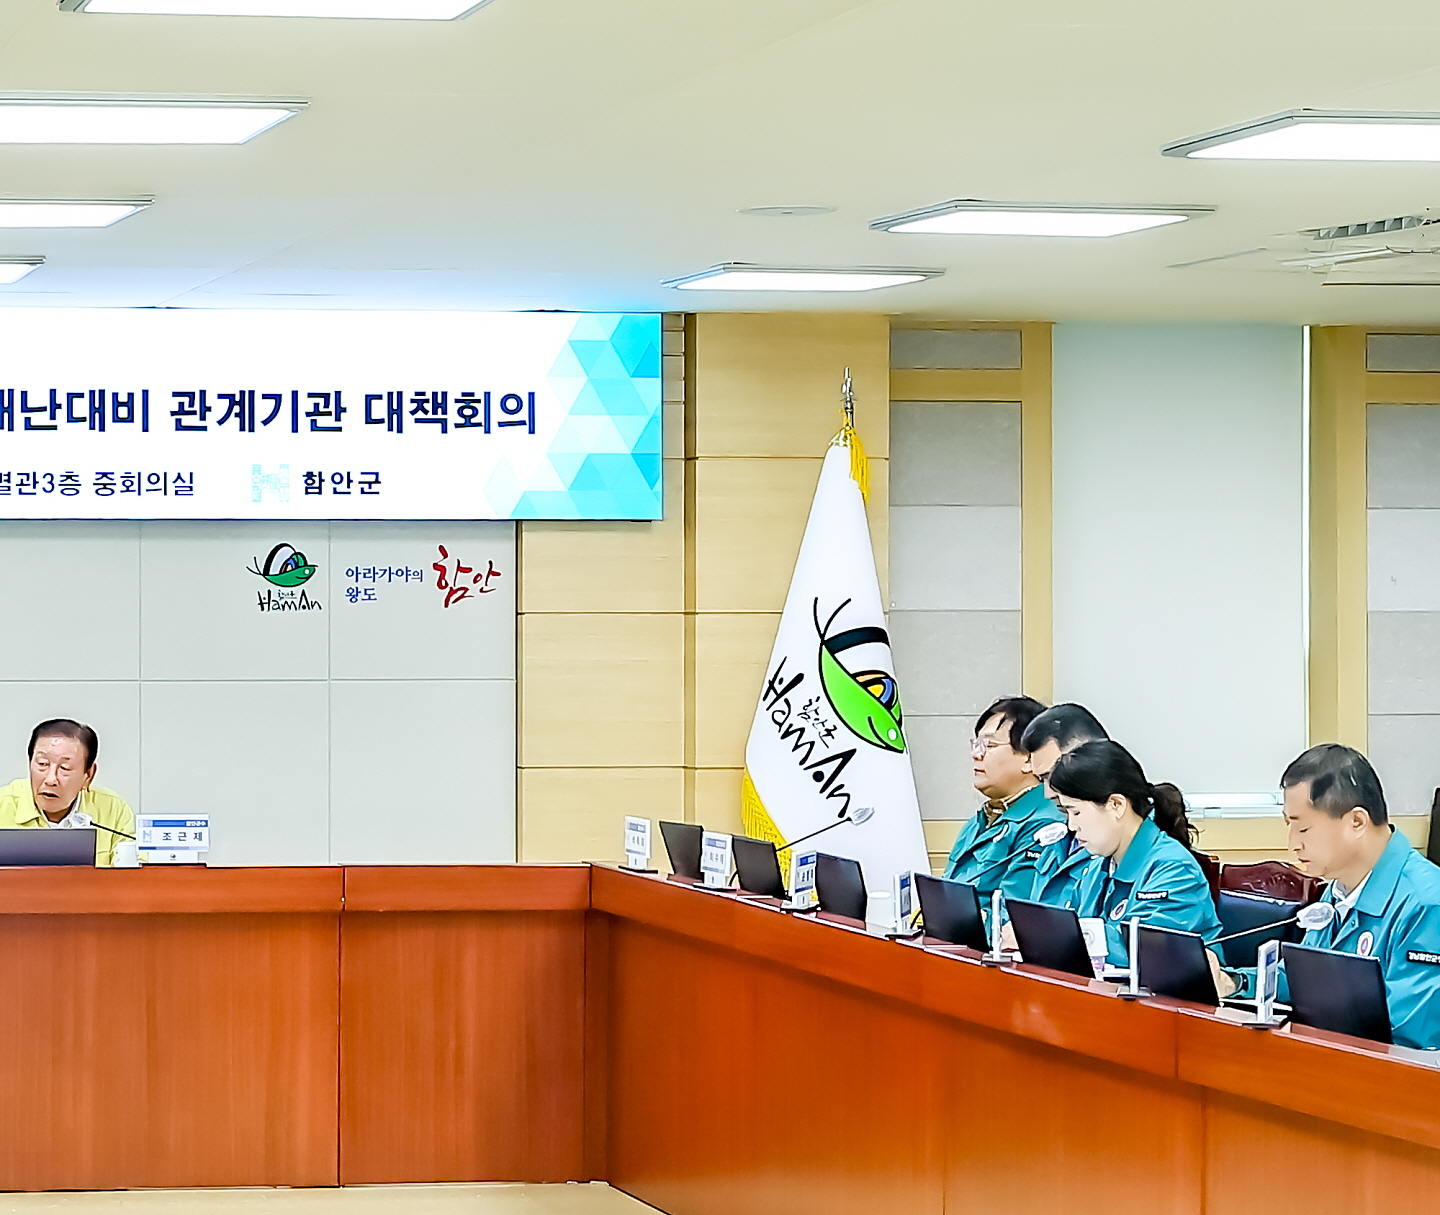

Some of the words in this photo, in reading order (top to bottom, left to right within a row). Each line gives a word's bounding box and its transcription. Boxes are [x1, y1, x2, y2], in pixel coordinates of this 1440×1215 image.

[169, 389, 348, 434] 관계기관
[364, 390, 536, 435] 대책회의
[92, 471, 194, 497] 중회의실
[302, 470, 382, 496] 함안군
[345, 566, 423, 583] 아라가야의
[432, 545, 502, 608] 함안
[345, 587, 378, 603] 왕도
[162, 831, 203, 842] 조근제
